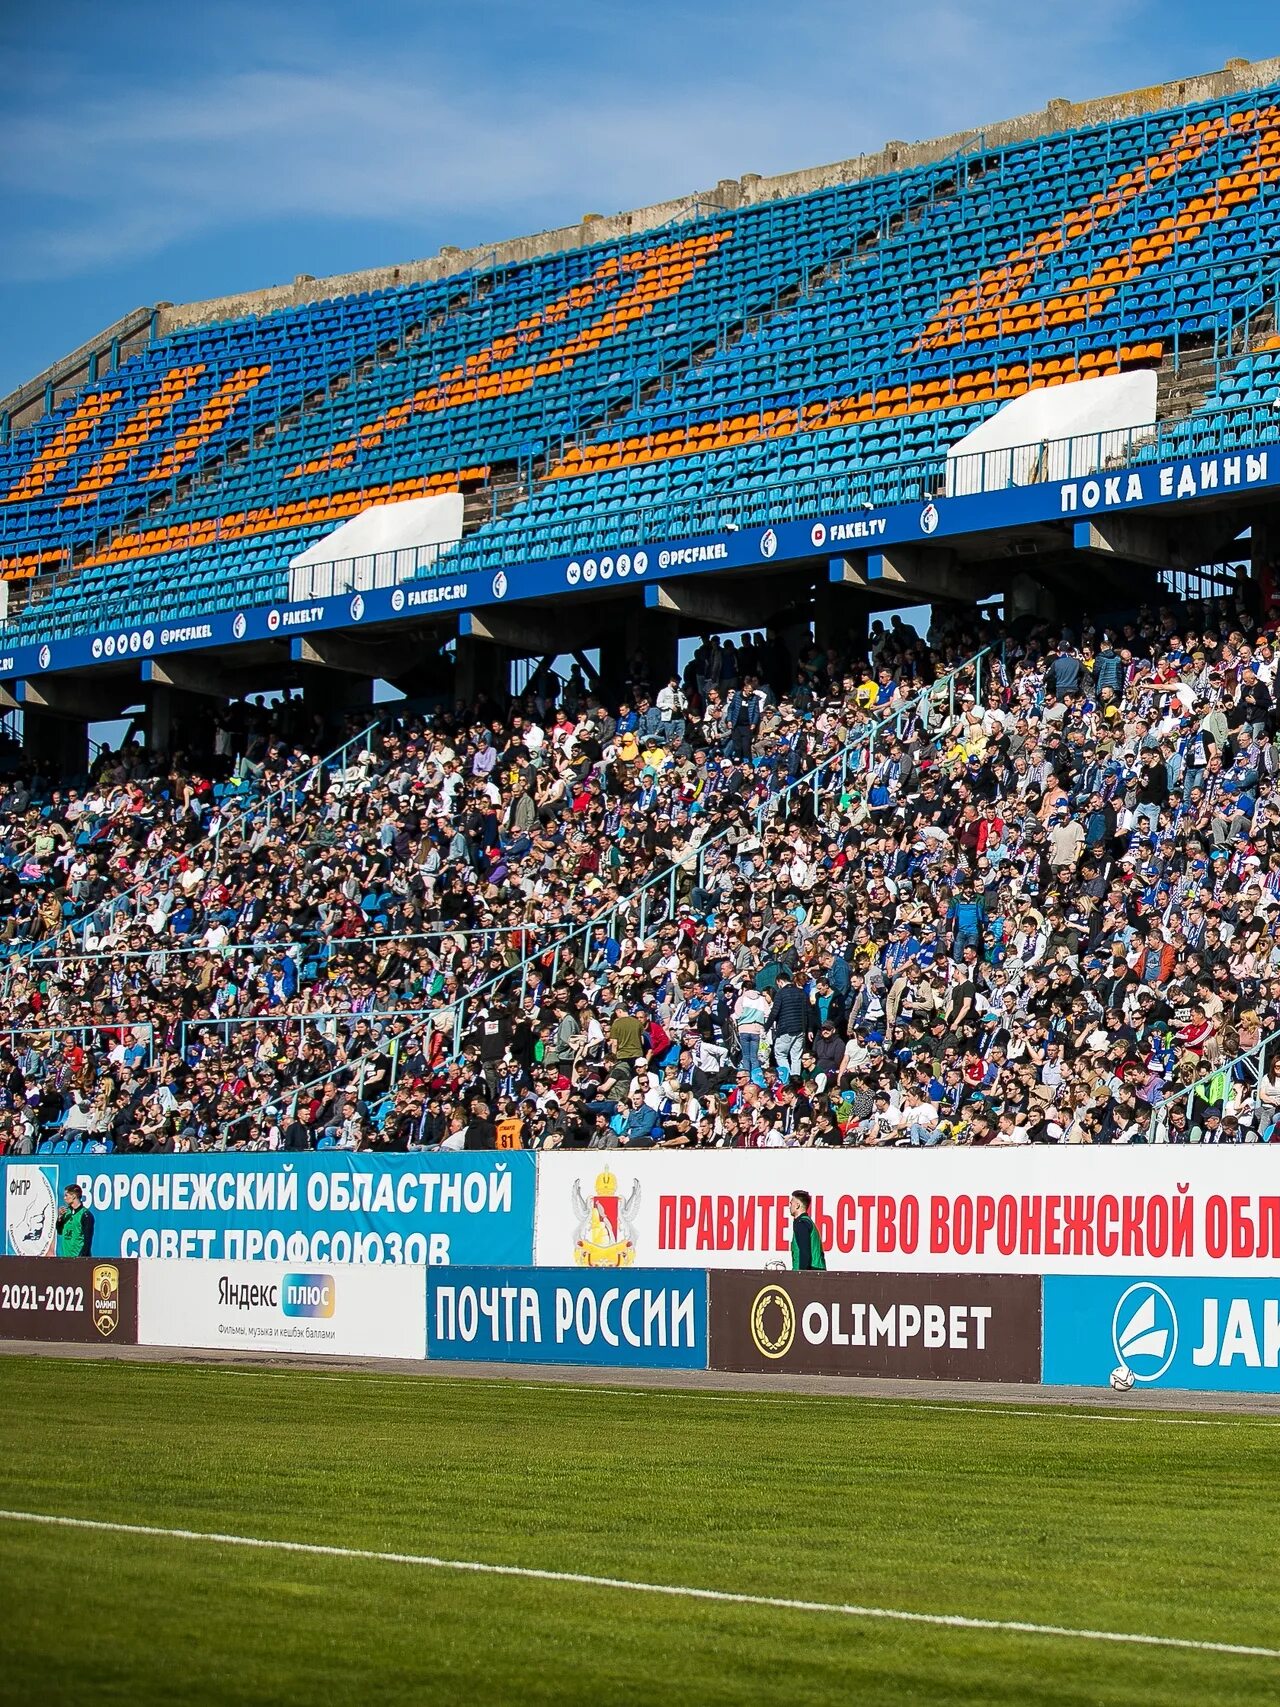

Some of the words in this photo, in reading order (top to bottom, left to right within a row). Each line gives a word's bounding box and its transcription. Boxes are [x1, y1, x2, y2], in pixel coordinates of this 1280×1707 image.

[1059, 470, 1144, 512] ПОКА
[1158, 453, 1269, 499] ЕДИНЫ
[828, 518, 887, 542] FAKELTV
[658, 542, 729, 569] @PFCFAKEL
[407, 583, 468, 607] FAKELFC.RU
[281, 606, 325, 627] FAKELTV
[160, 623, 213, 646] @PFCFAKEL
[501, 1134, 513, 1148] 81
[9, 1178, 31, 1195] ФНПР
[76, 1164, 299, 1211] ВОРОНЕЖСКИЙ
[307, 1163, 512, 1213] ОБЛАСТНОЙ
[658, 1194, 920, 1255] ПРАВИТЕЬСТВО
[930, 1182, 1194, 1258] ВОРОНЕЖСКОЙ
[120, 1228, 216, 1260] СОВЕТ
[223, 1229, 451, 1266] ПРОФСОЮЗОВ
[1, 1284, 84, 1312] 2021-2022
[218, 1276, 278, 1311] Яндекс
[436, 1285, 542, 1343] ПОЧТА
[556, 1287, 695, 1348] РОССИИ
[802, 1302, 992, 1350] OLIMPBET
[218, 1324, 248, 1337] Фильмы,
[248, 1327, 273, 1338] музыка
[274, 1328, 279, 1337] и
[280, 1326, 305, 1338] кешбэк
[305, 1327, 336, 1340] баллами
